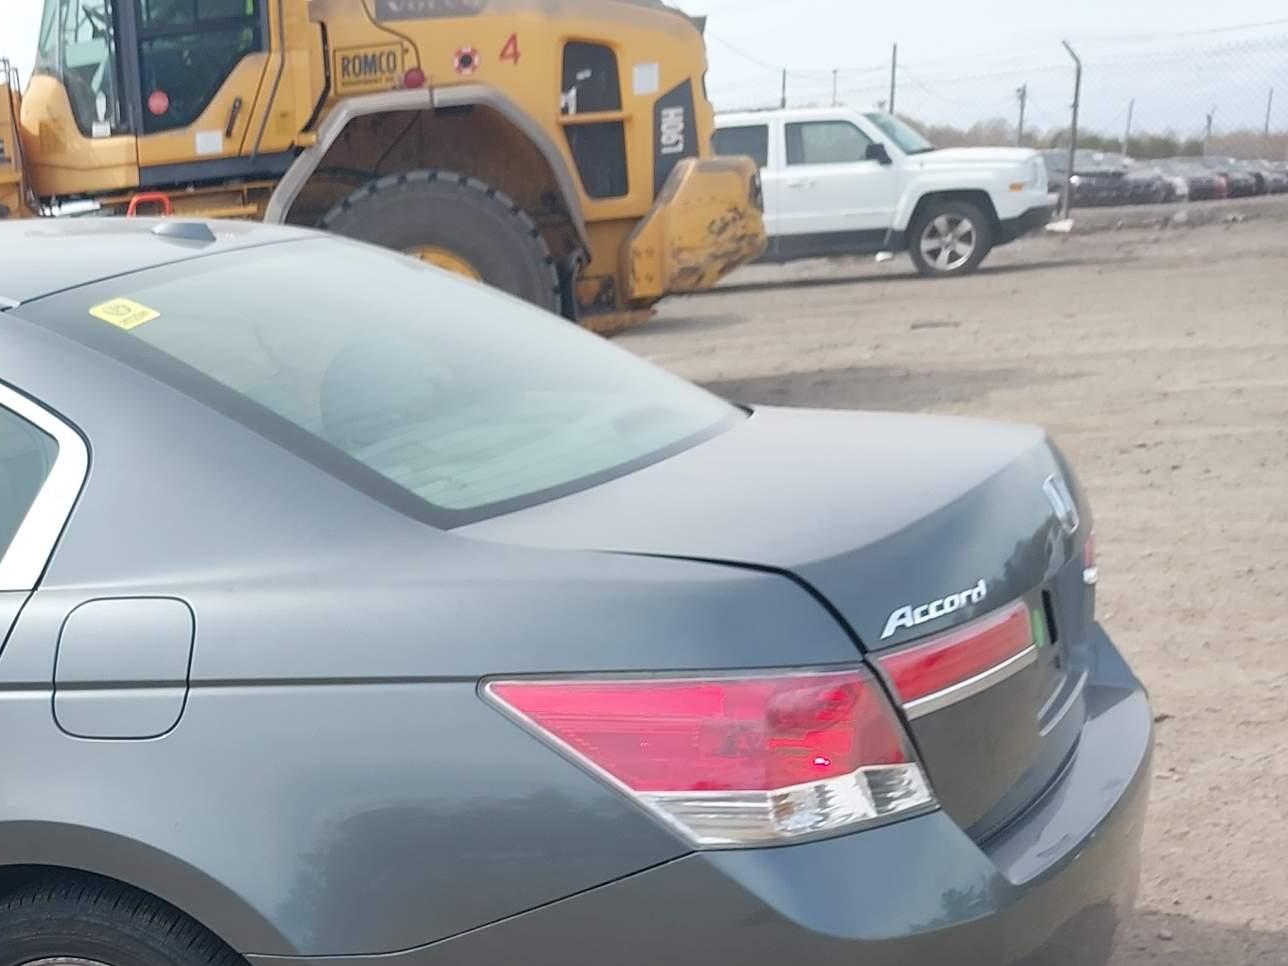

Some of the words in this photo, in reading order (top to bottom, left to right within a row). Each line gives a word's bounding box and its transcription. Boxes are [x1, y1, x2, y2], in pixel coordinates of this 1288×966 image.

[341, 50, 397, 79] ROMCO
[498, 31, 521, 65] 4
[661, 107, 684, 154] L90H
[880, 579, 987, 640] Accord
